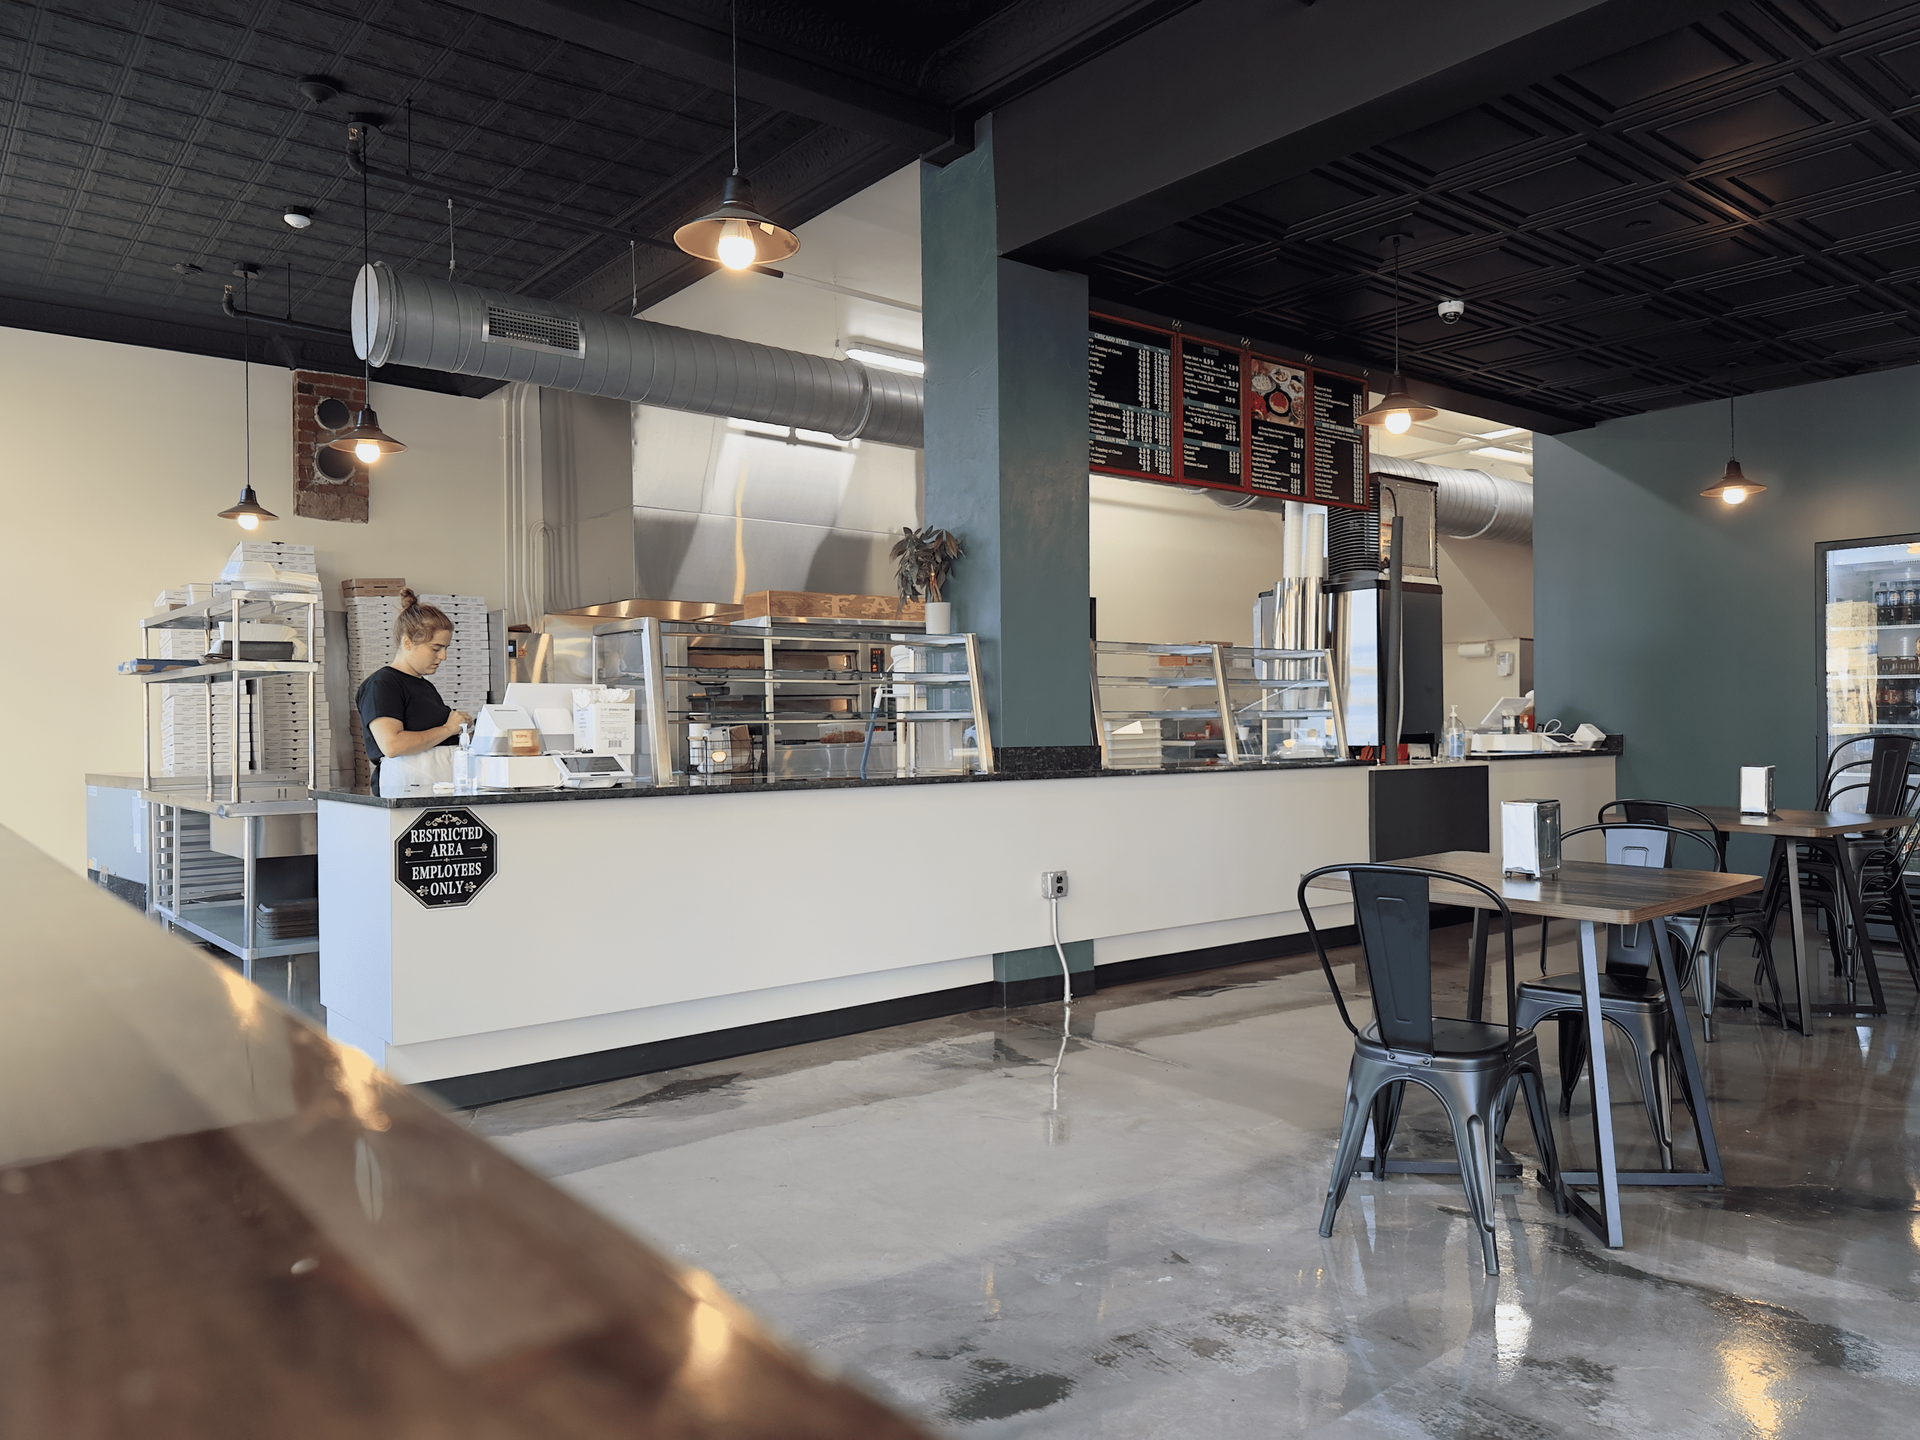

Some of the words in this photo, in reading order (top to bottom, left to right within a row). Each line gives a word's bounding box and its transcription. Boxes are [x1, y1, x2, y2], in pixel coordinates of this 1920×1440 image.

[410, 826, 483, 843] RESTRICTED
[430, 842, 464, 857] AREA
[412, 862, 482, 880] EMPLOYEES
[430, 880, 464, 896] ONLY
